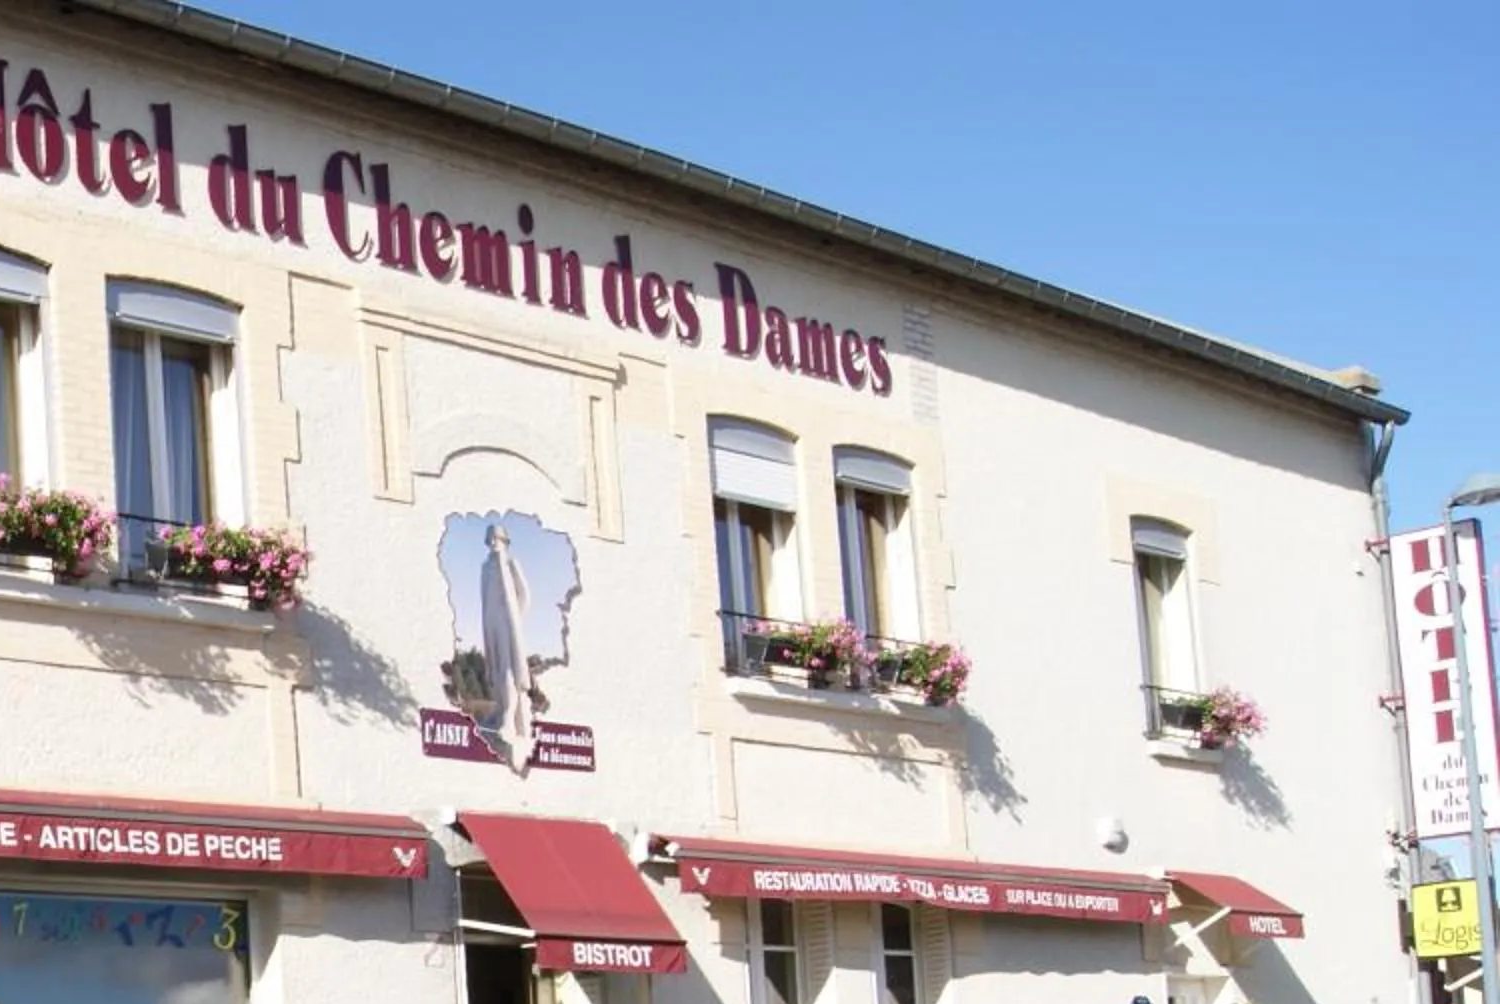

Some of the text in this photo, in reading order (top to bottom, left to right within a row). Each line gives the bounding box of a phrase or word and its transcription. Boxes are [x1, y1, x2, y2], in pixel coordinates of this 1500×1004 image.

[208, 124, 307, 246] du
[323, 150, 587, 318] Chemin
[602, 235, 700, 345] des
[714, 261, 892, 397] Dames
[40, 825, 160, 855] ARTICLES
[166, 831, 200, 857] DE
[204, 834, 283, 861] PECHE
[753, 870, 852, 893] RESTAURATION
[853, 873, 901, 893] RAPIDE
[942, 883, 990, 904] GLACES
[573, 942, 653, 967] BISTROT
